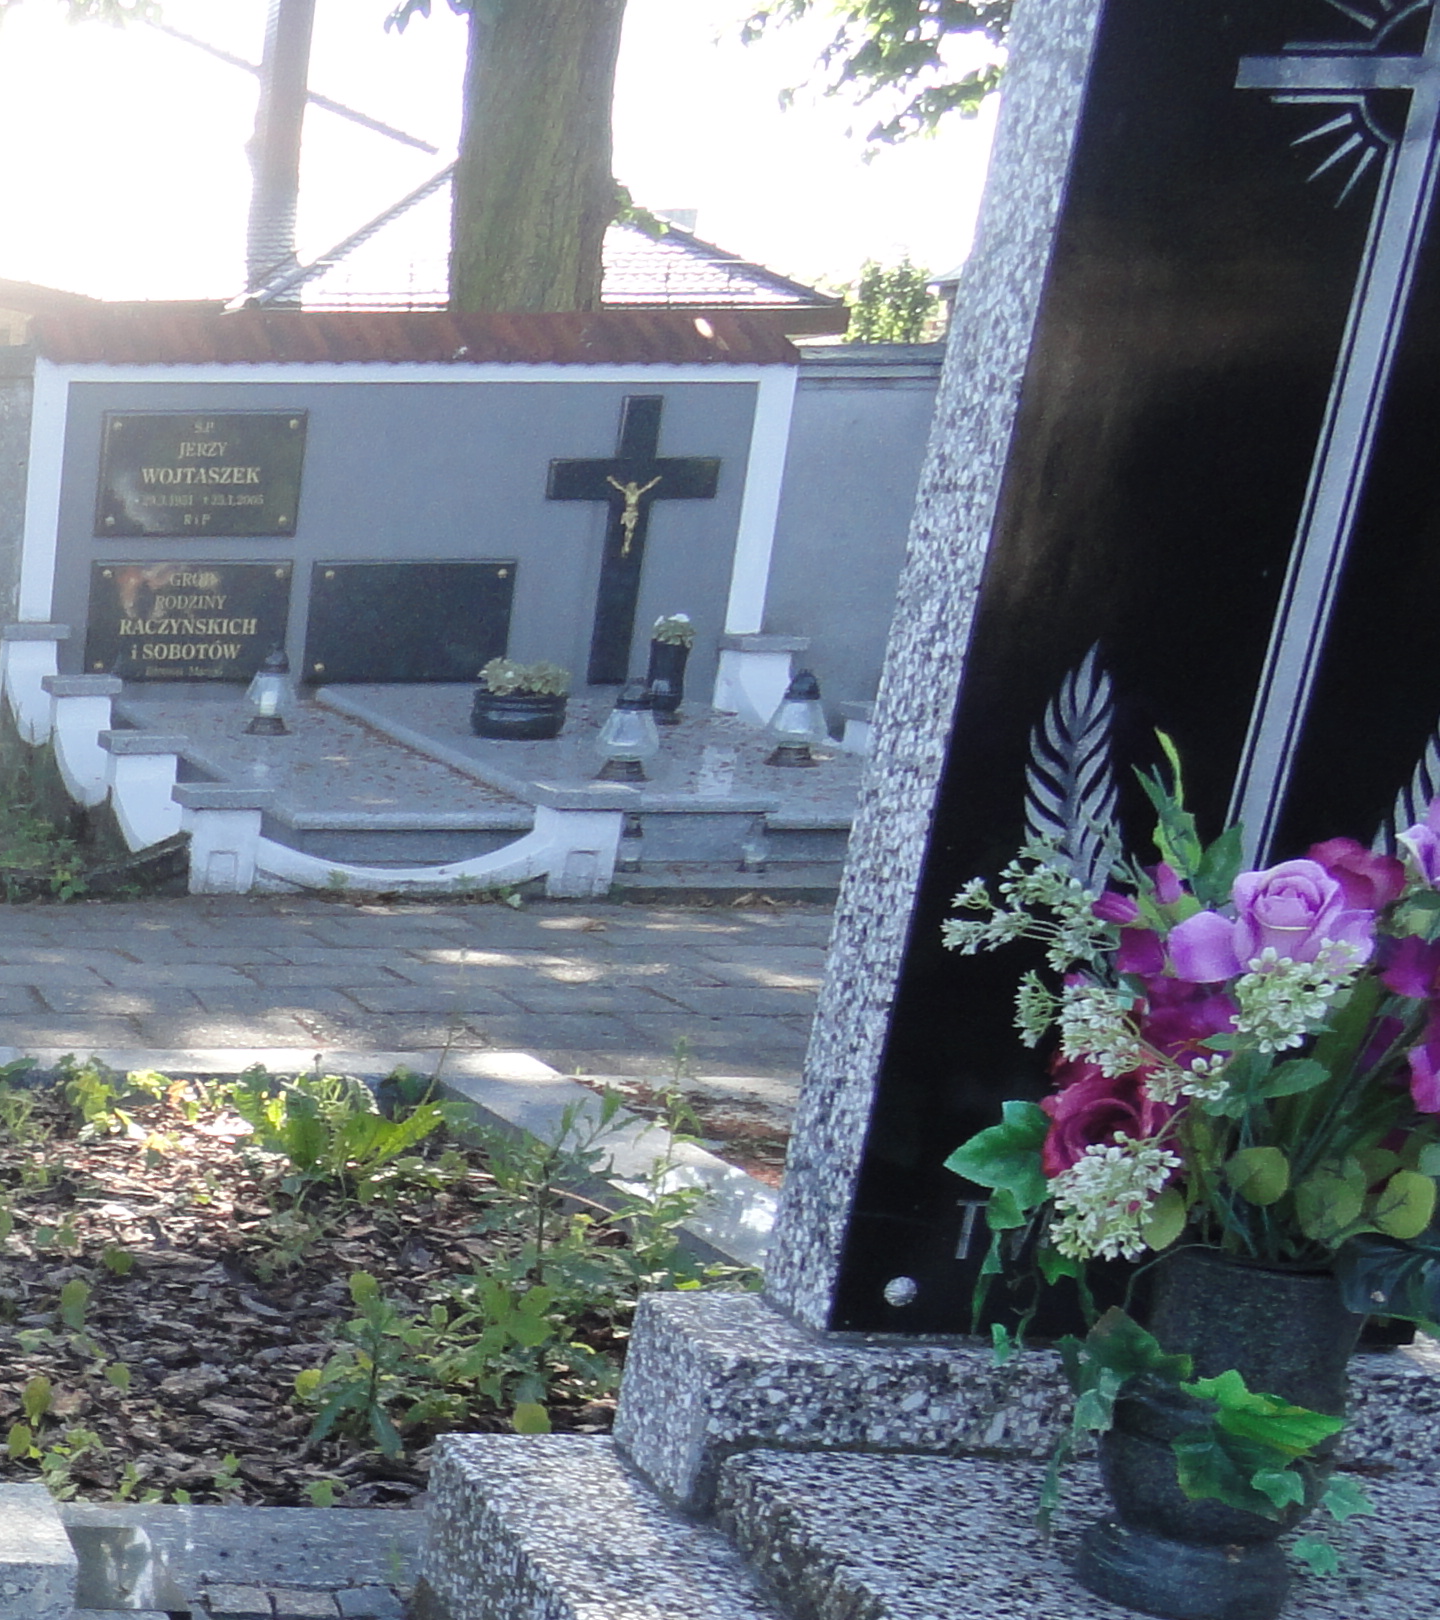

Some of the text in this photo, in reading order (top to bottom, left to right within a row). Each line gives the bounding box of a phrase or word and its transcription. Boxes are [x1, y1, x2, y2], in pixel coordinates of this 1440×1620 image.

[178, 441, 228, 459] JERZY
[141, 466, 261, 485] WOJTASZEK
[154, 594, 227, 610] RODZINY
[142, 640, 242, 661] SOBOTÓW
